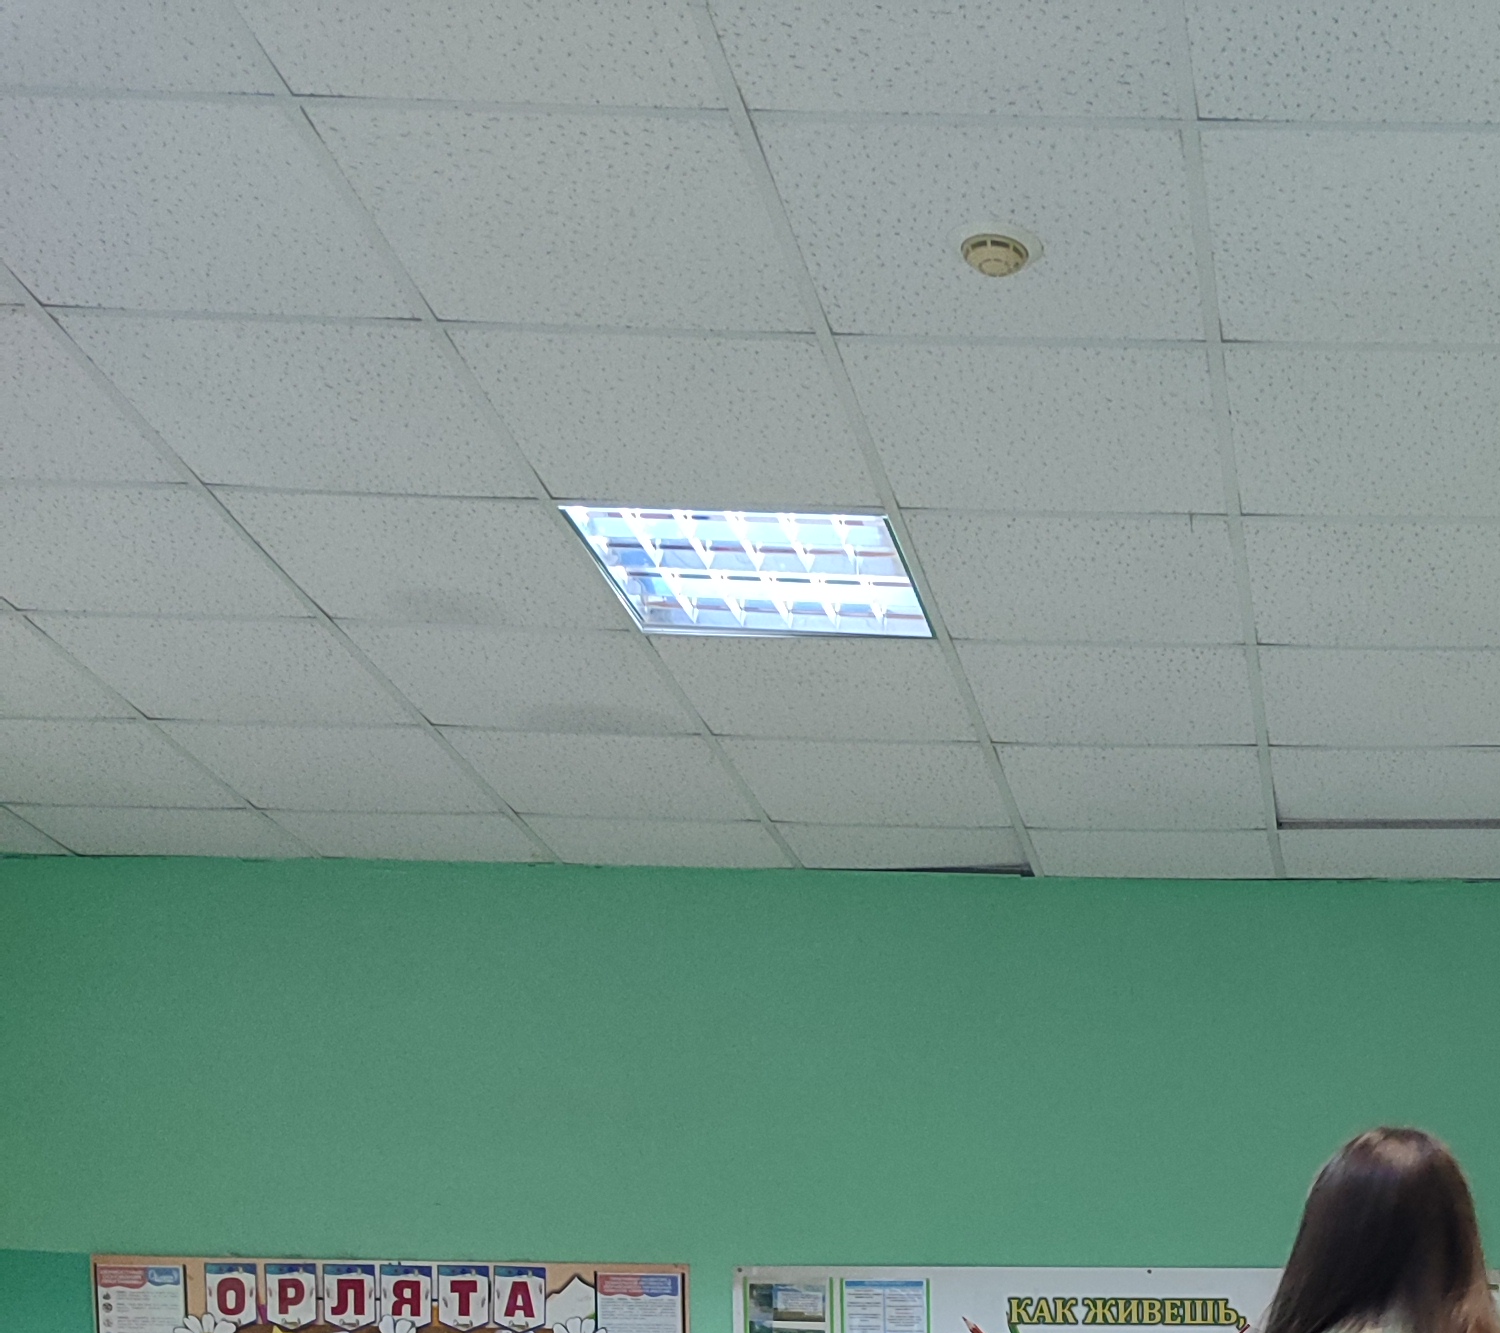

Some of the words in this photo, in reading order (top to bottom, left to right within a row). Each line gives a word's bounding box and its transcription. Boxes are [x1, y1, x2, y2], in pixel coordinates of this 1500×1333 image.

[216, 1276, 541, 1319] ОРЛЯТА
[1008, 1297, 1077, 1326] КАК
[1084, 1297, 1246, 1329] ЖИВЕШЬ,
